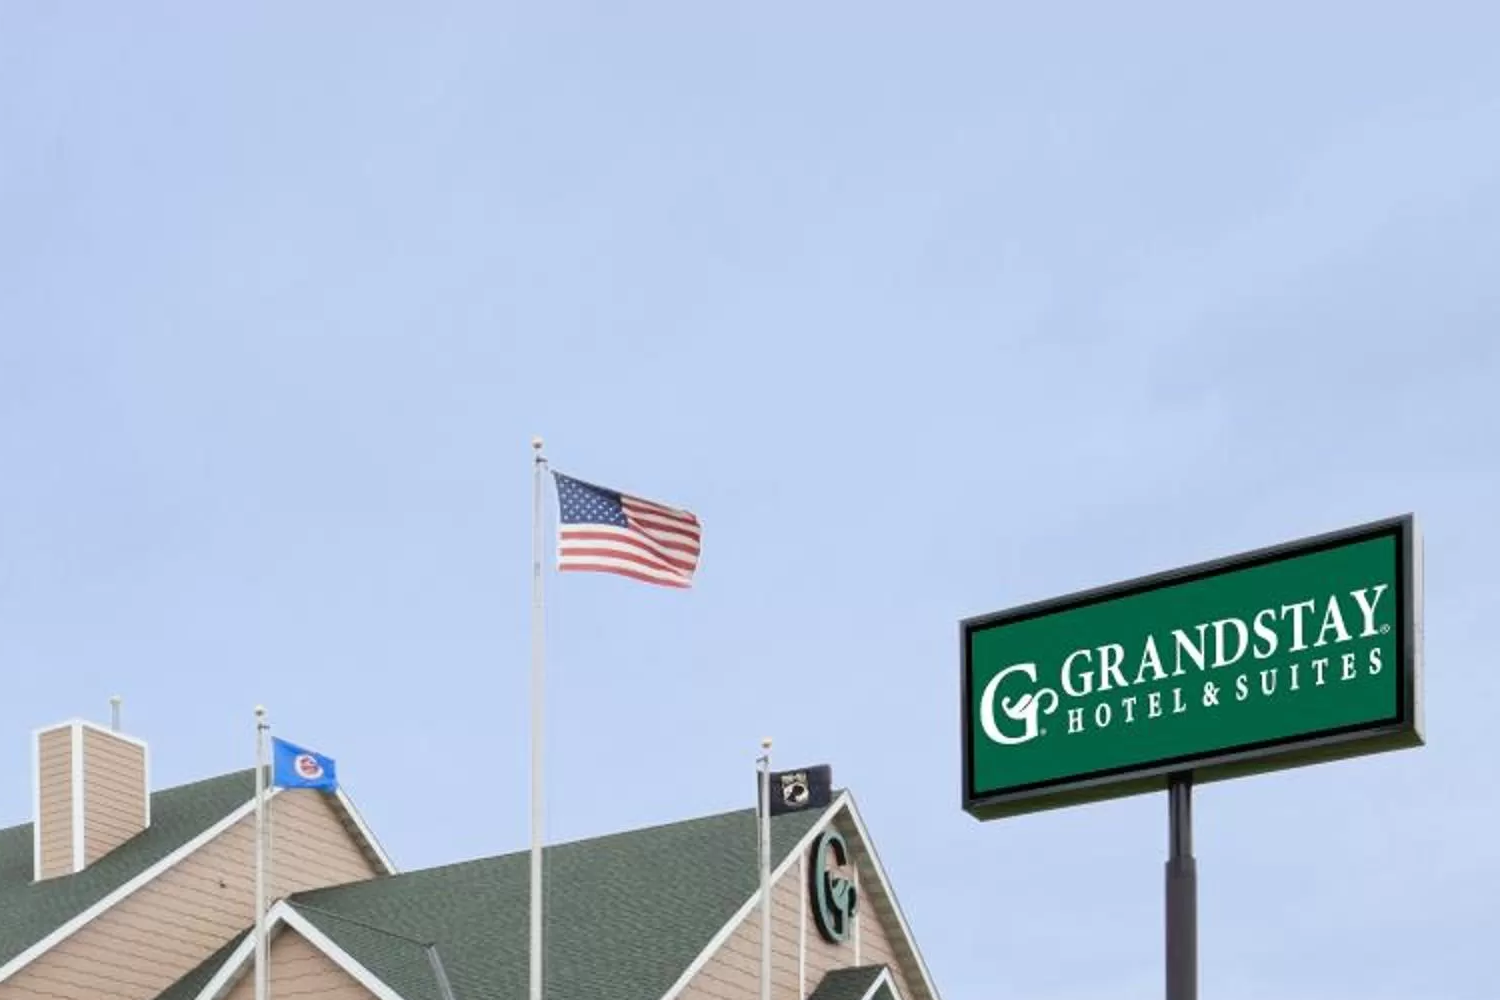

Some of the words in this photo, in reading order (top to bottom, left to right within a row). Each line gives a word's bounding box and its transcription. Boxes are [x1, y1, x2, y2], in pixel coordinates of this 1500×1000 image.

[1061, 584, 1387, 697] GRANDSTAY
[1067, 687, 1188, 734] HOTEL
[1202, 681, 1220, 707] &
[1235, 647, 1382, 701] SUITES
